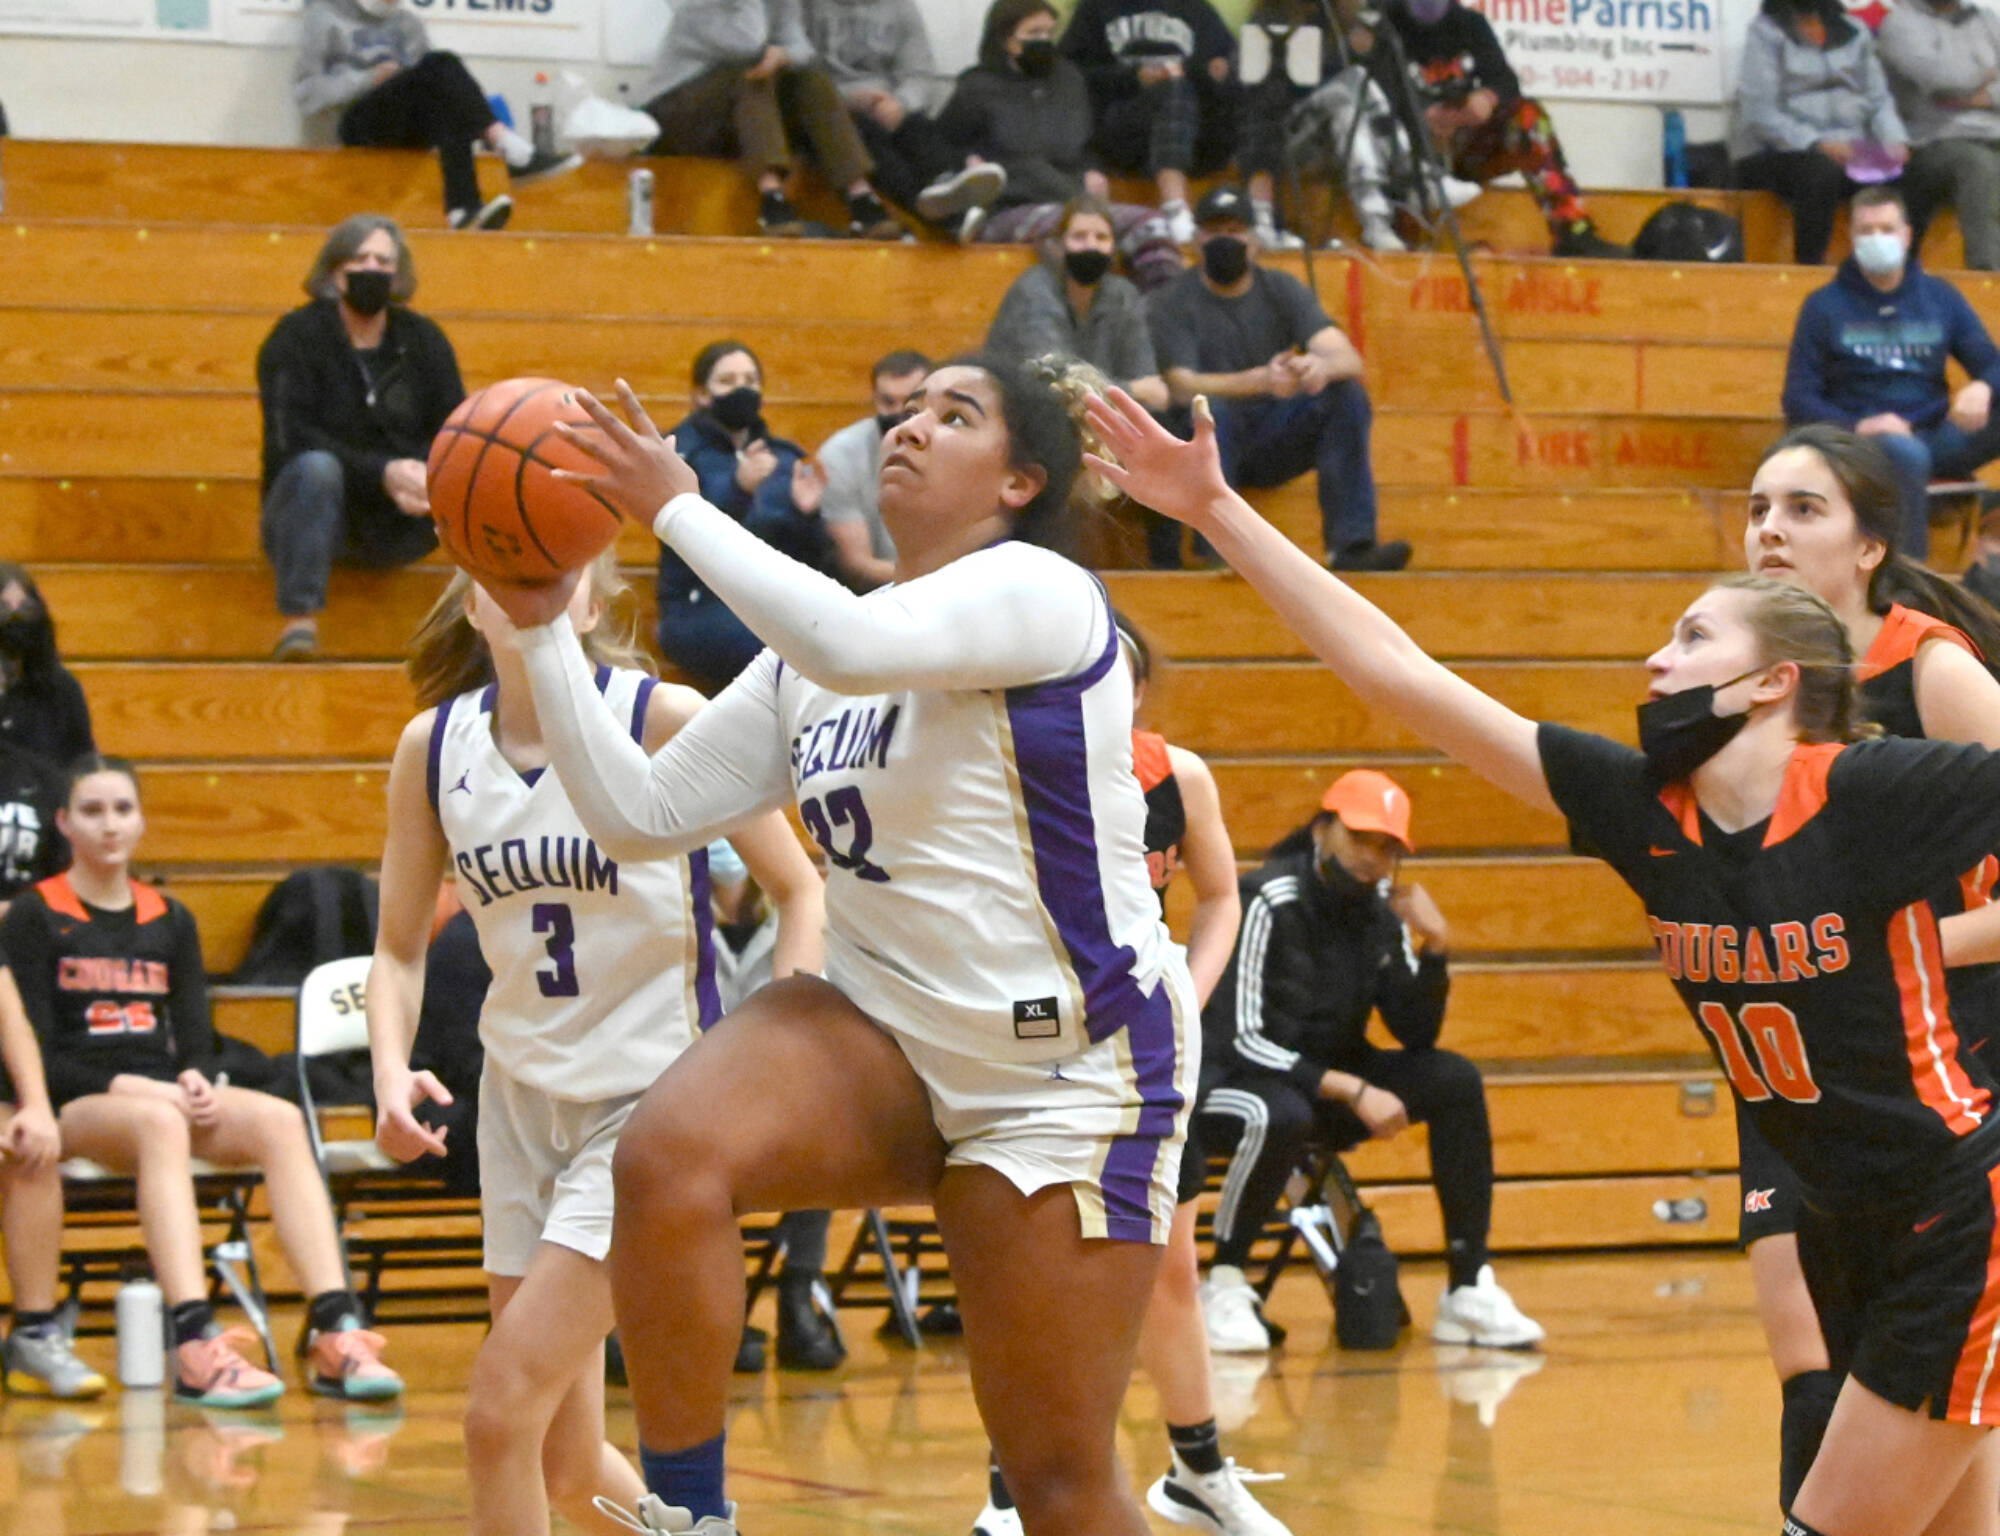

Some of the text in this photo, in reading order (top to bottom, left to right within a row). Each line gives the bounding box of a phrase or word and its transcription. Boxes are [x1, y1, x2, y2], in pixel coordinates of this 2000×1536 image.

[1504, 29, 1615, 60] Plumbing
[456, 835, 619, 907] SEQUIM
[532, 903, 580, 998] 3
[1024, 1003, 1048, 1018] XL
[1699, 1001, 1822, 1104] 10
